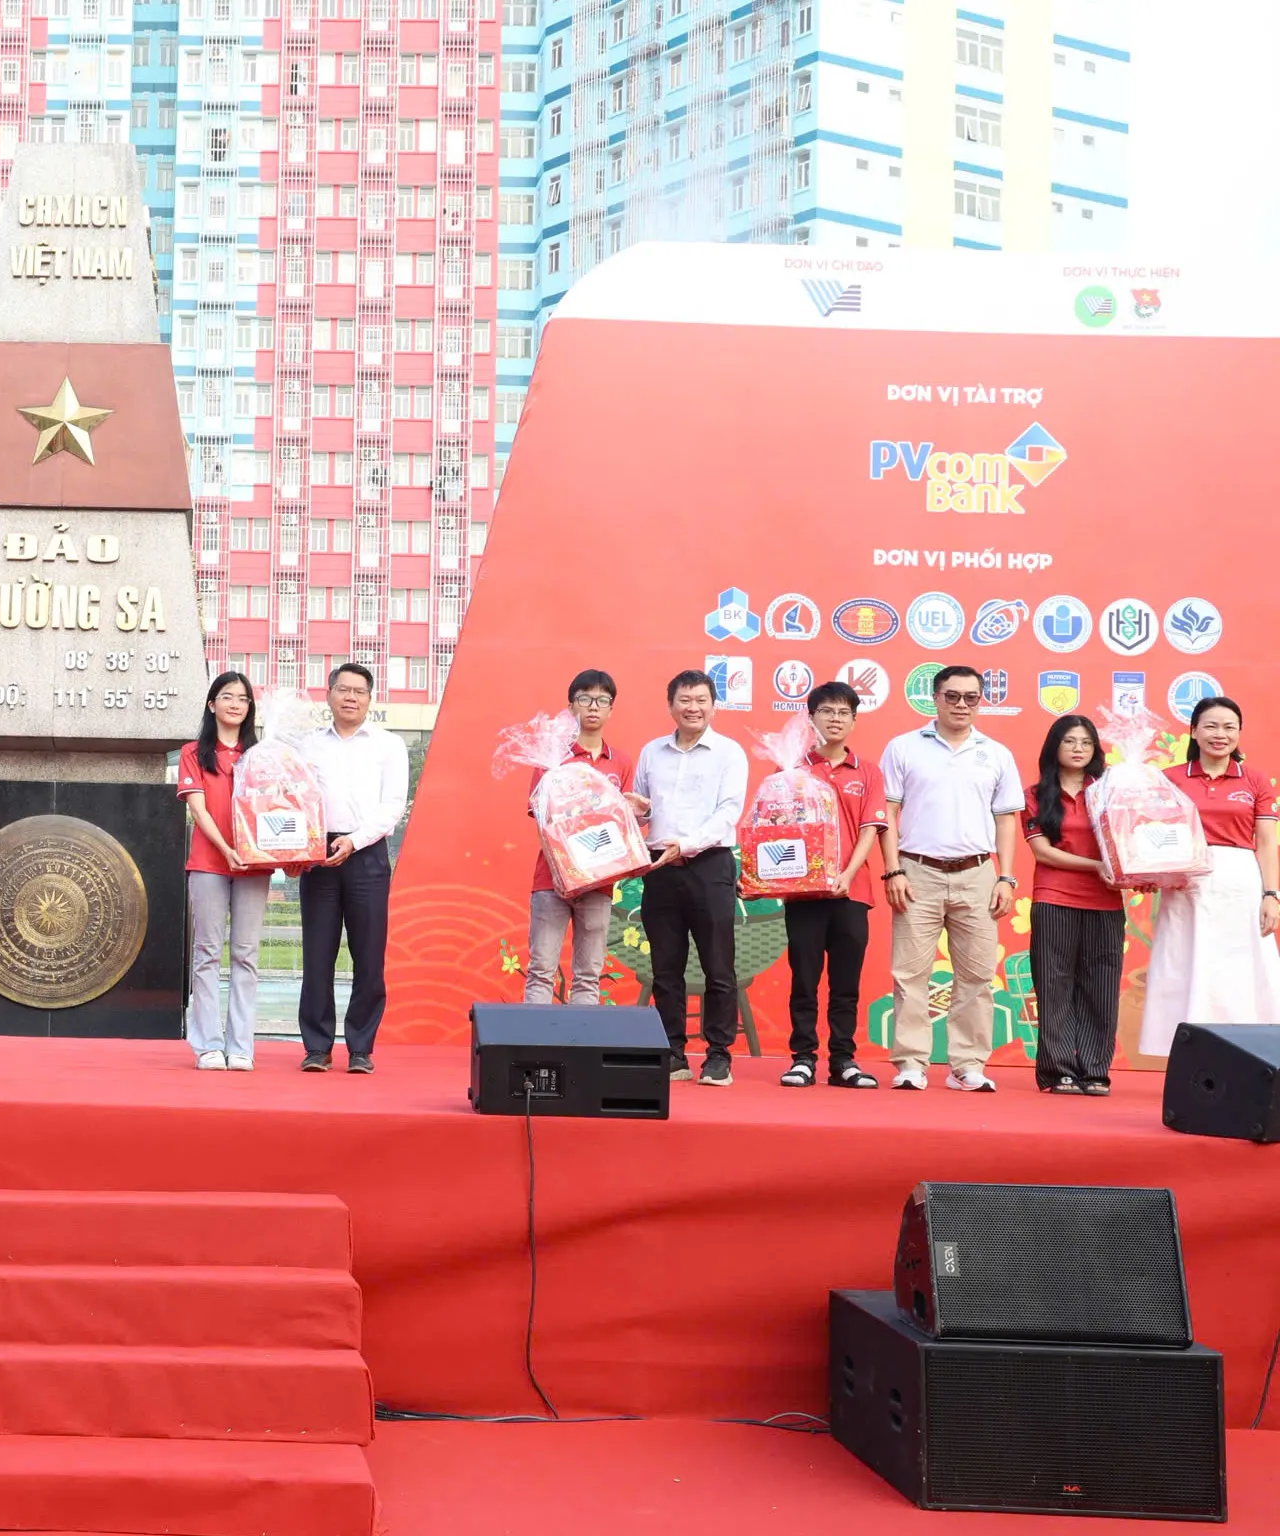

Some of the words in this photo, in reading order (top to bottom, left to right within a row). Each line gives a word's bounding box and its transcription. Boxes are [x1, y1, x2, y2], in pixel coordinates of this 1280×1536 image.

[18, 194, 127, 227] CHXHCN
[10, 243, 66, 285] VIỆT
[72, 247, 133, 280] NAM
[887, 384, 932, 402] ĐƠN
[937, 385, 959, 407] VỊ
[964, 383, 996, 403] TÀI
[1000, 387, 1043, 408] TRỢ
[927, 479, 1025, 513] Bank
[4, 522, 120, 563] ĐẢO
[873, 548, 918, 566] ĐƠN
[924, 550, 946, 571] VỊ
[951, 547, 1002, 569] PHỐI
[1007, 552, 1053, 573] HỢP
[116, 585, 166, 632] SA
[723, 609, 742, 620] BK
[918, 611, 952, 627] UEL
[859, 698, 877, 706] AH
[943, 1246, 955, 1273] NEXO
